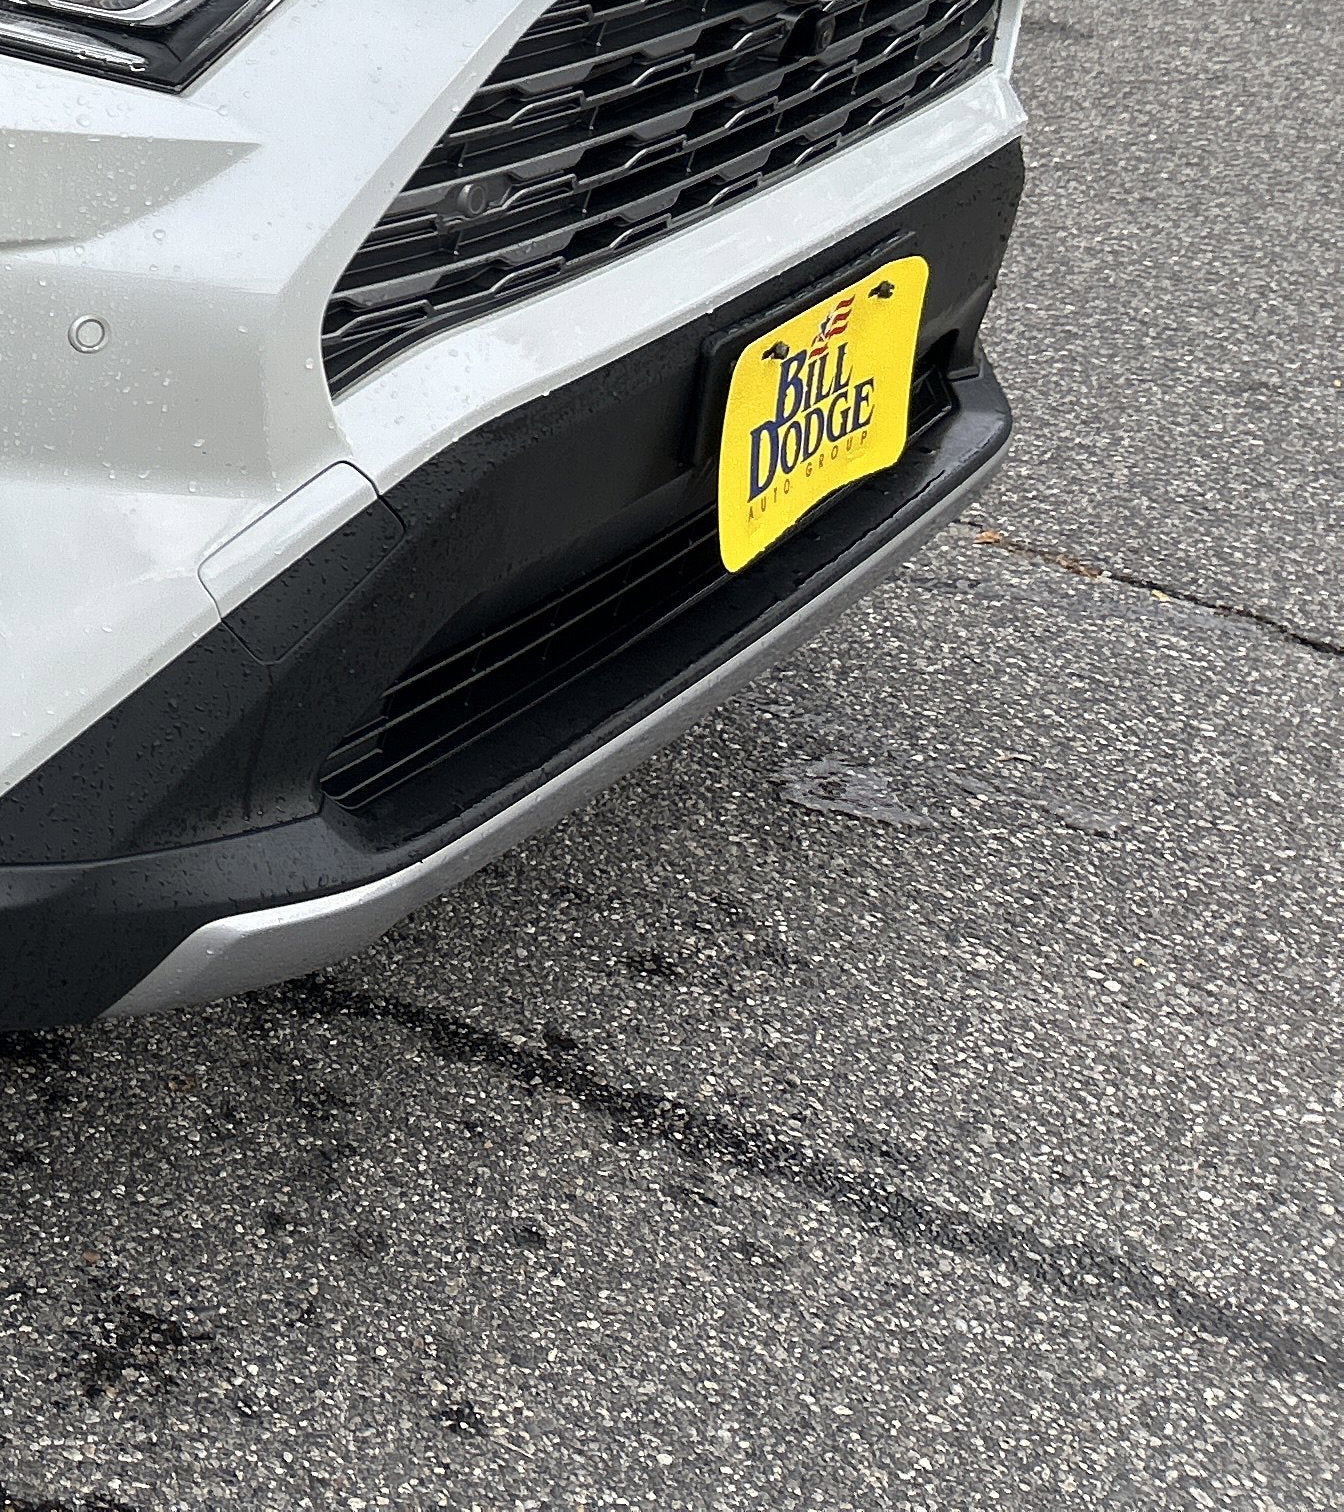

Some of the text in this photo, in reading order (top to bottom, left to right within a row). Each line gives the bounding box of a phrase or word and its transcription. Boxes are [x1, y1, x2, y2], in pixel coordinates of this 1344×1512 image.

[775, 341, 854, 425] BILL
[747, 377, 876, 503] DODGE
[747, 429, 869, 520] AUTO GROUP
